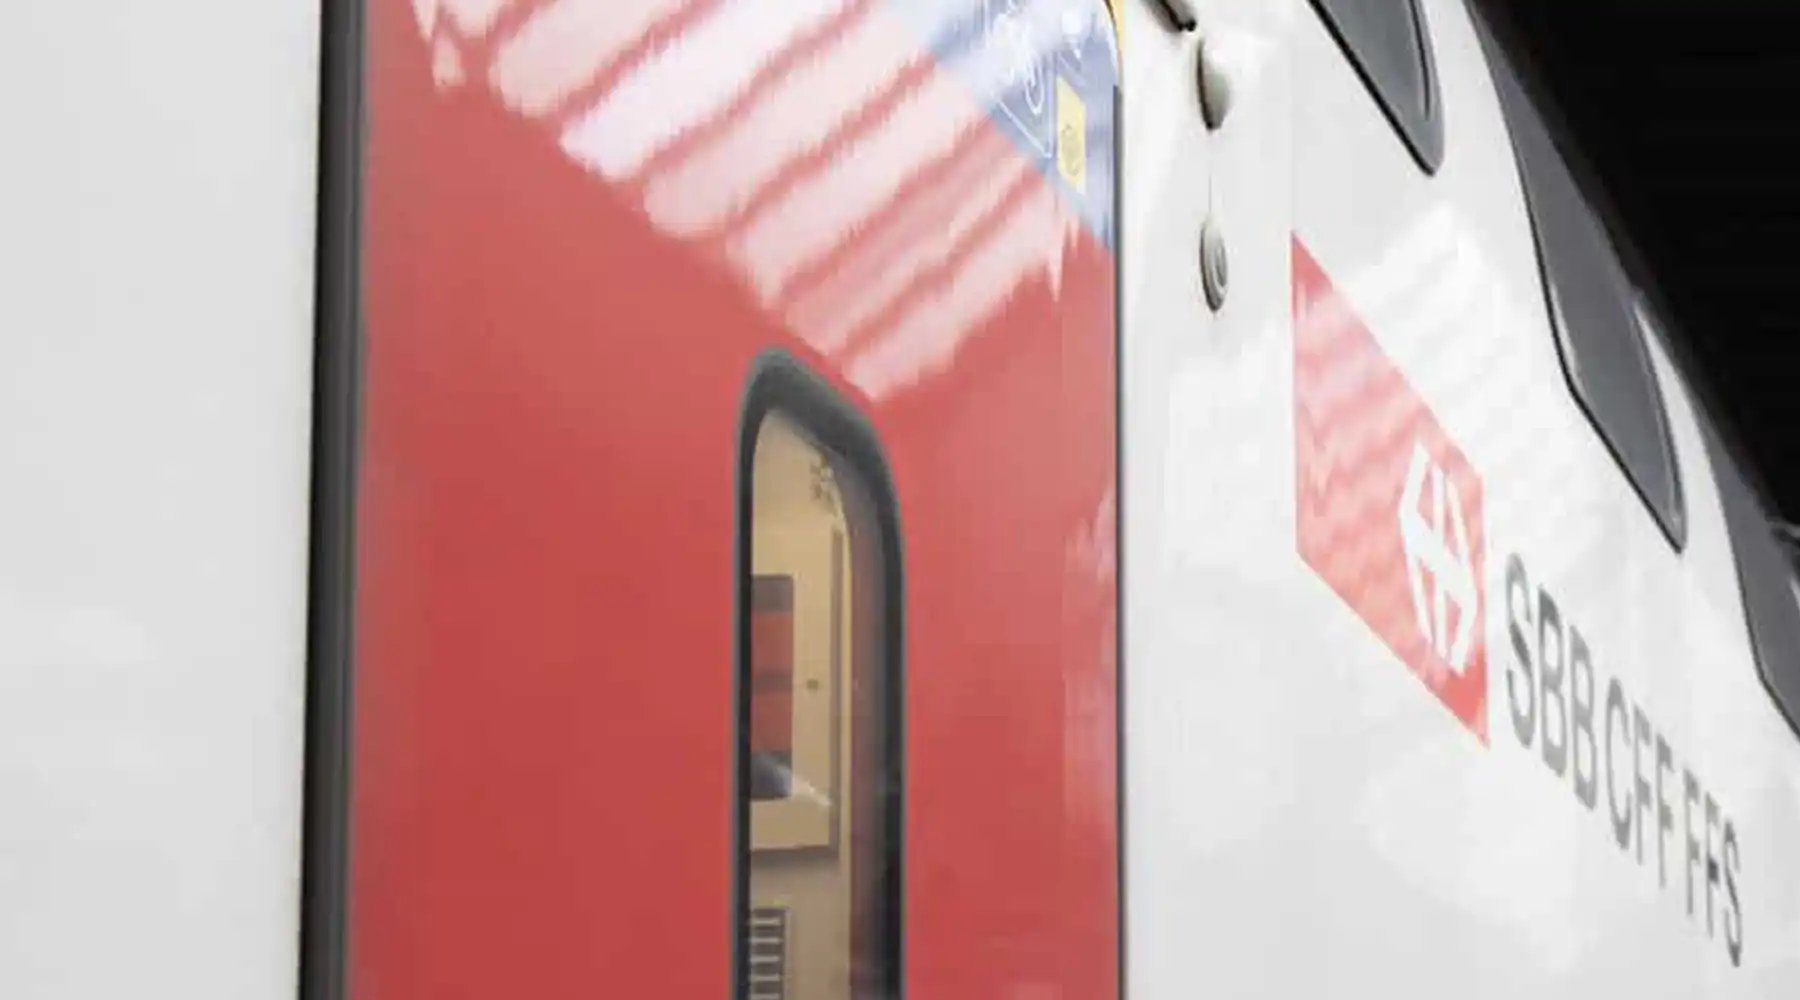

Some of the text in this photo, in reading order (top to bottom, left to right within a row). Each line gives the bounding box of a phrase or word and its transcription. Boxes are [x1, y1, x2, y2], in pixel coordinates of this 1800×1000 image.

[1506, 553, 1742, 967] SBB CFF FFS
